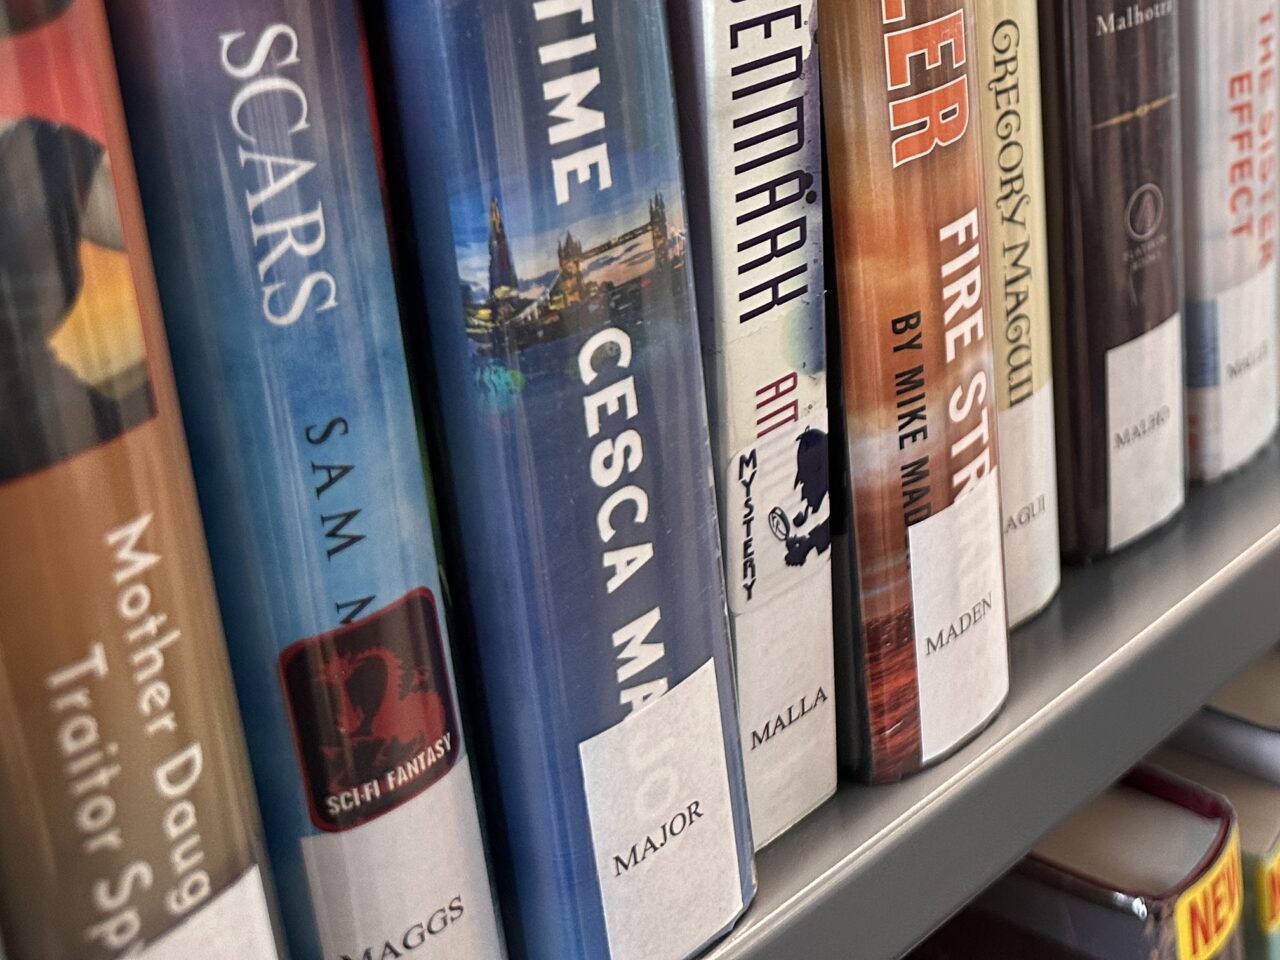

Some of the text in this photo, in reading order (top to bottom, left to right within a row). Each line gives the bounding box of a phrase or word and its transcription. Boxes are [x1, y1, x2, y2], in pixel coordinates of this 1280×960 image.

[218, 22, 339, 327] SCARS
[991, 18, 1032, 227] GREGORY
[1226, 69, 1255, 240] EFFECT
[891, 310, 922, 353] BY
[938, 207, 985, 364] FIRE
[577, 327, 656, 594] CESCA
[895, 364, 928, 451] MIKE
[305, 415, 366, 562] SAM
[738, 448, 758, 601] MYSTERY
[1003, 494, 1046, 535] AGUI
[104, 511, 183, 736] Mother
[923, 591, 994, 656] MADEN
[45, 640, 122, 852] Traitor
[325, 730, 454, 818] SCI-FI FANTASY
[749, 685, 828, 752] MALLA
[611, 799, 706, 878] MAJOR
[1188, 850, 1240, 957] NEW
